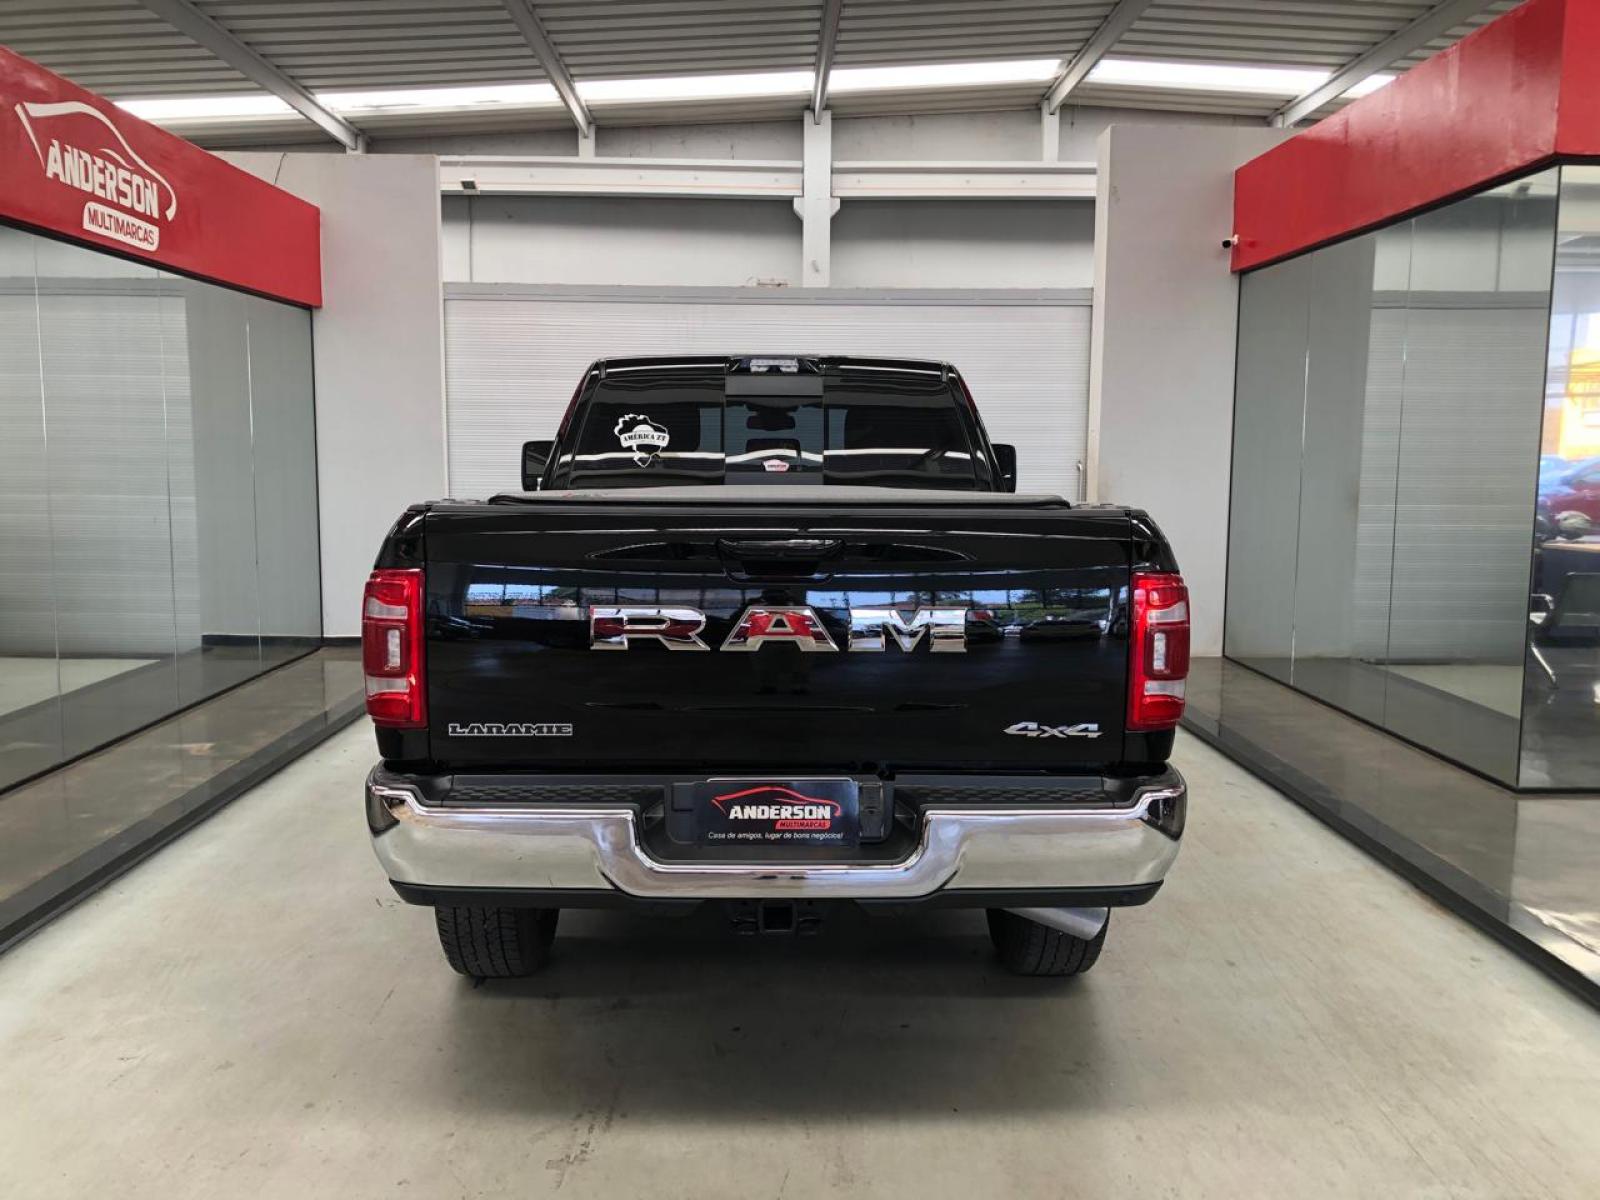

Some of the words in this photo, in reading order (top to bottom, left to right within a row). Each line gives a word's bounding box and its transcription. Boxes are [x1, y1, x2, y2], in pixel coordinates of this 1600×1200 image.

[46, 139, 159, 218] ANDERSON
[88, 207, 155, 246] MULTIMARCAS
[590, 604, 967, 652] RAM
[448, 723, 574, 736] LARAMIE
[729, 805, 831, 820] ANDERSON
[708, 831, 726, 840] Casa
[765, 831, 782, 841] lugar
[783, 831, 792, 839] de
[793, 831, 810, 839] bons
